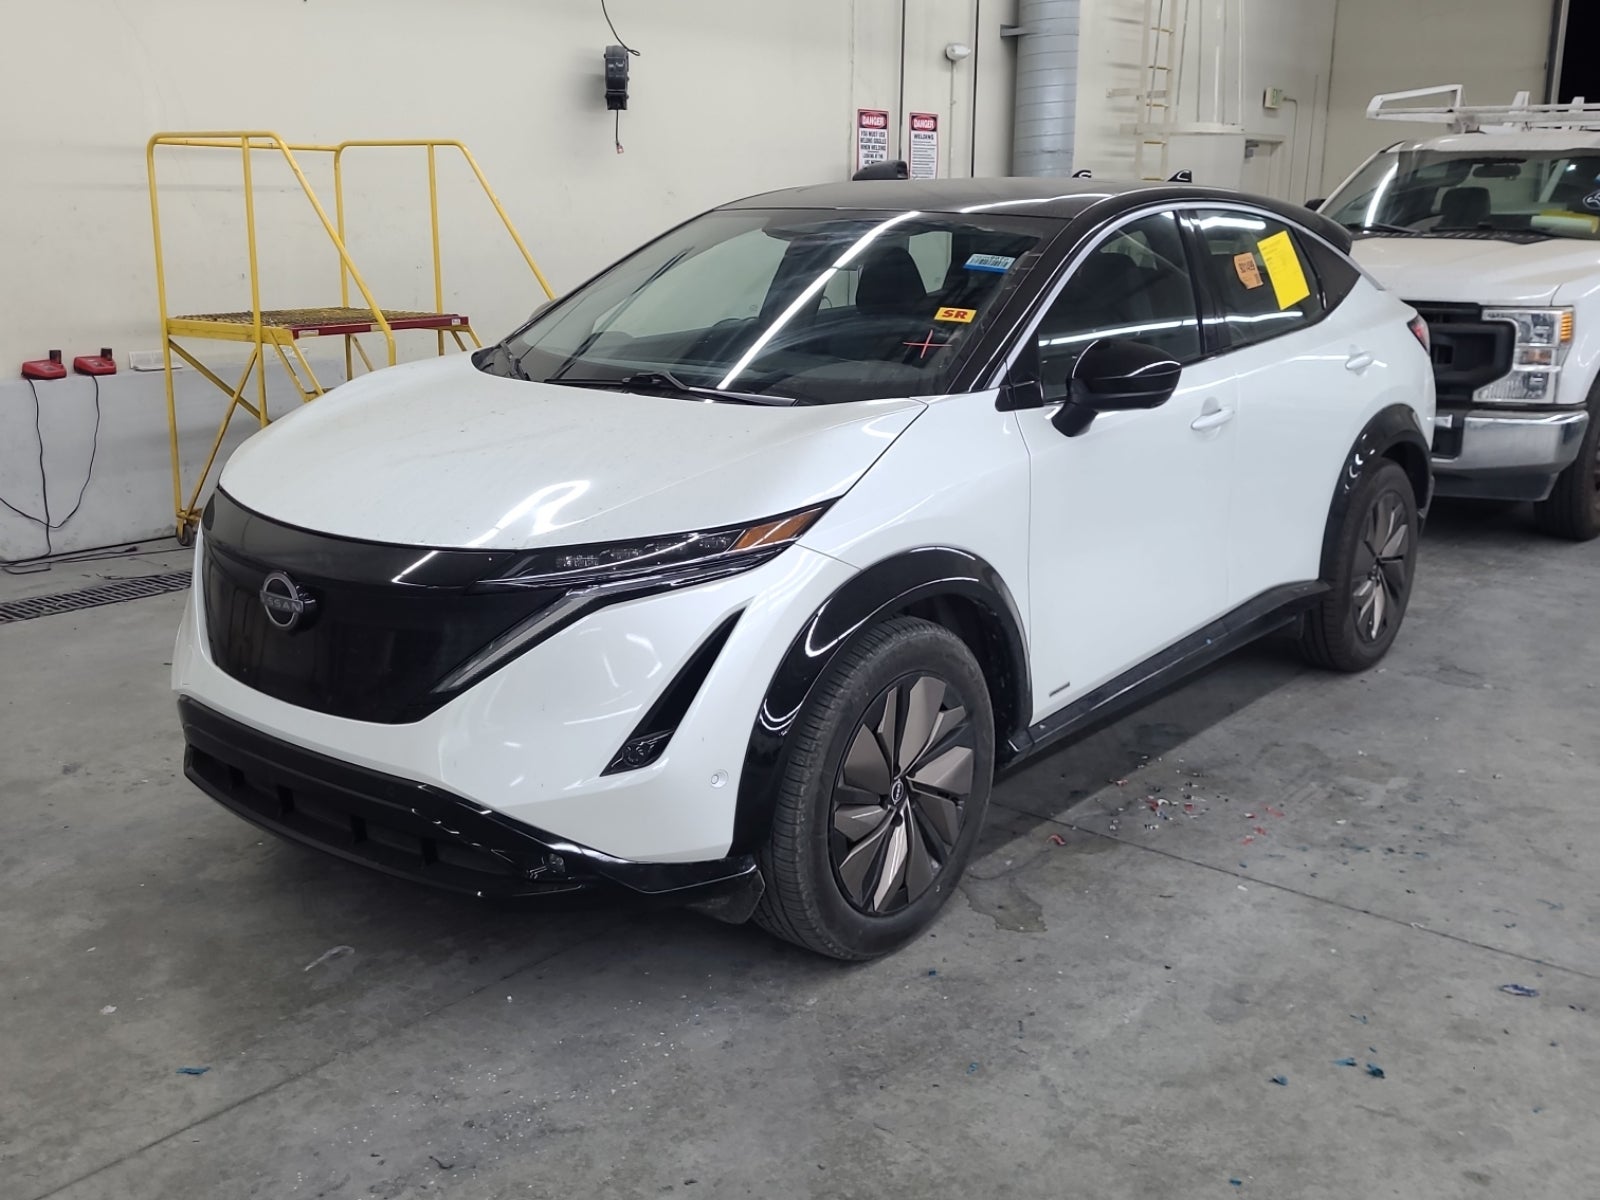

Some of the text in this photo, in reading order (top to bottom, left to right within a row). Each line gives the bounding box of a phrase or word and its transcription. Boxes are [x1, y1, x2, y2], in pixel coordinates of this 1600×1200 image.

[861, 115, 885, 126] DANGER
[913, 119, 934, 129] DANGER
[942, 309, 968, 319] SR
[263, 594, 301, 612] SSAN
